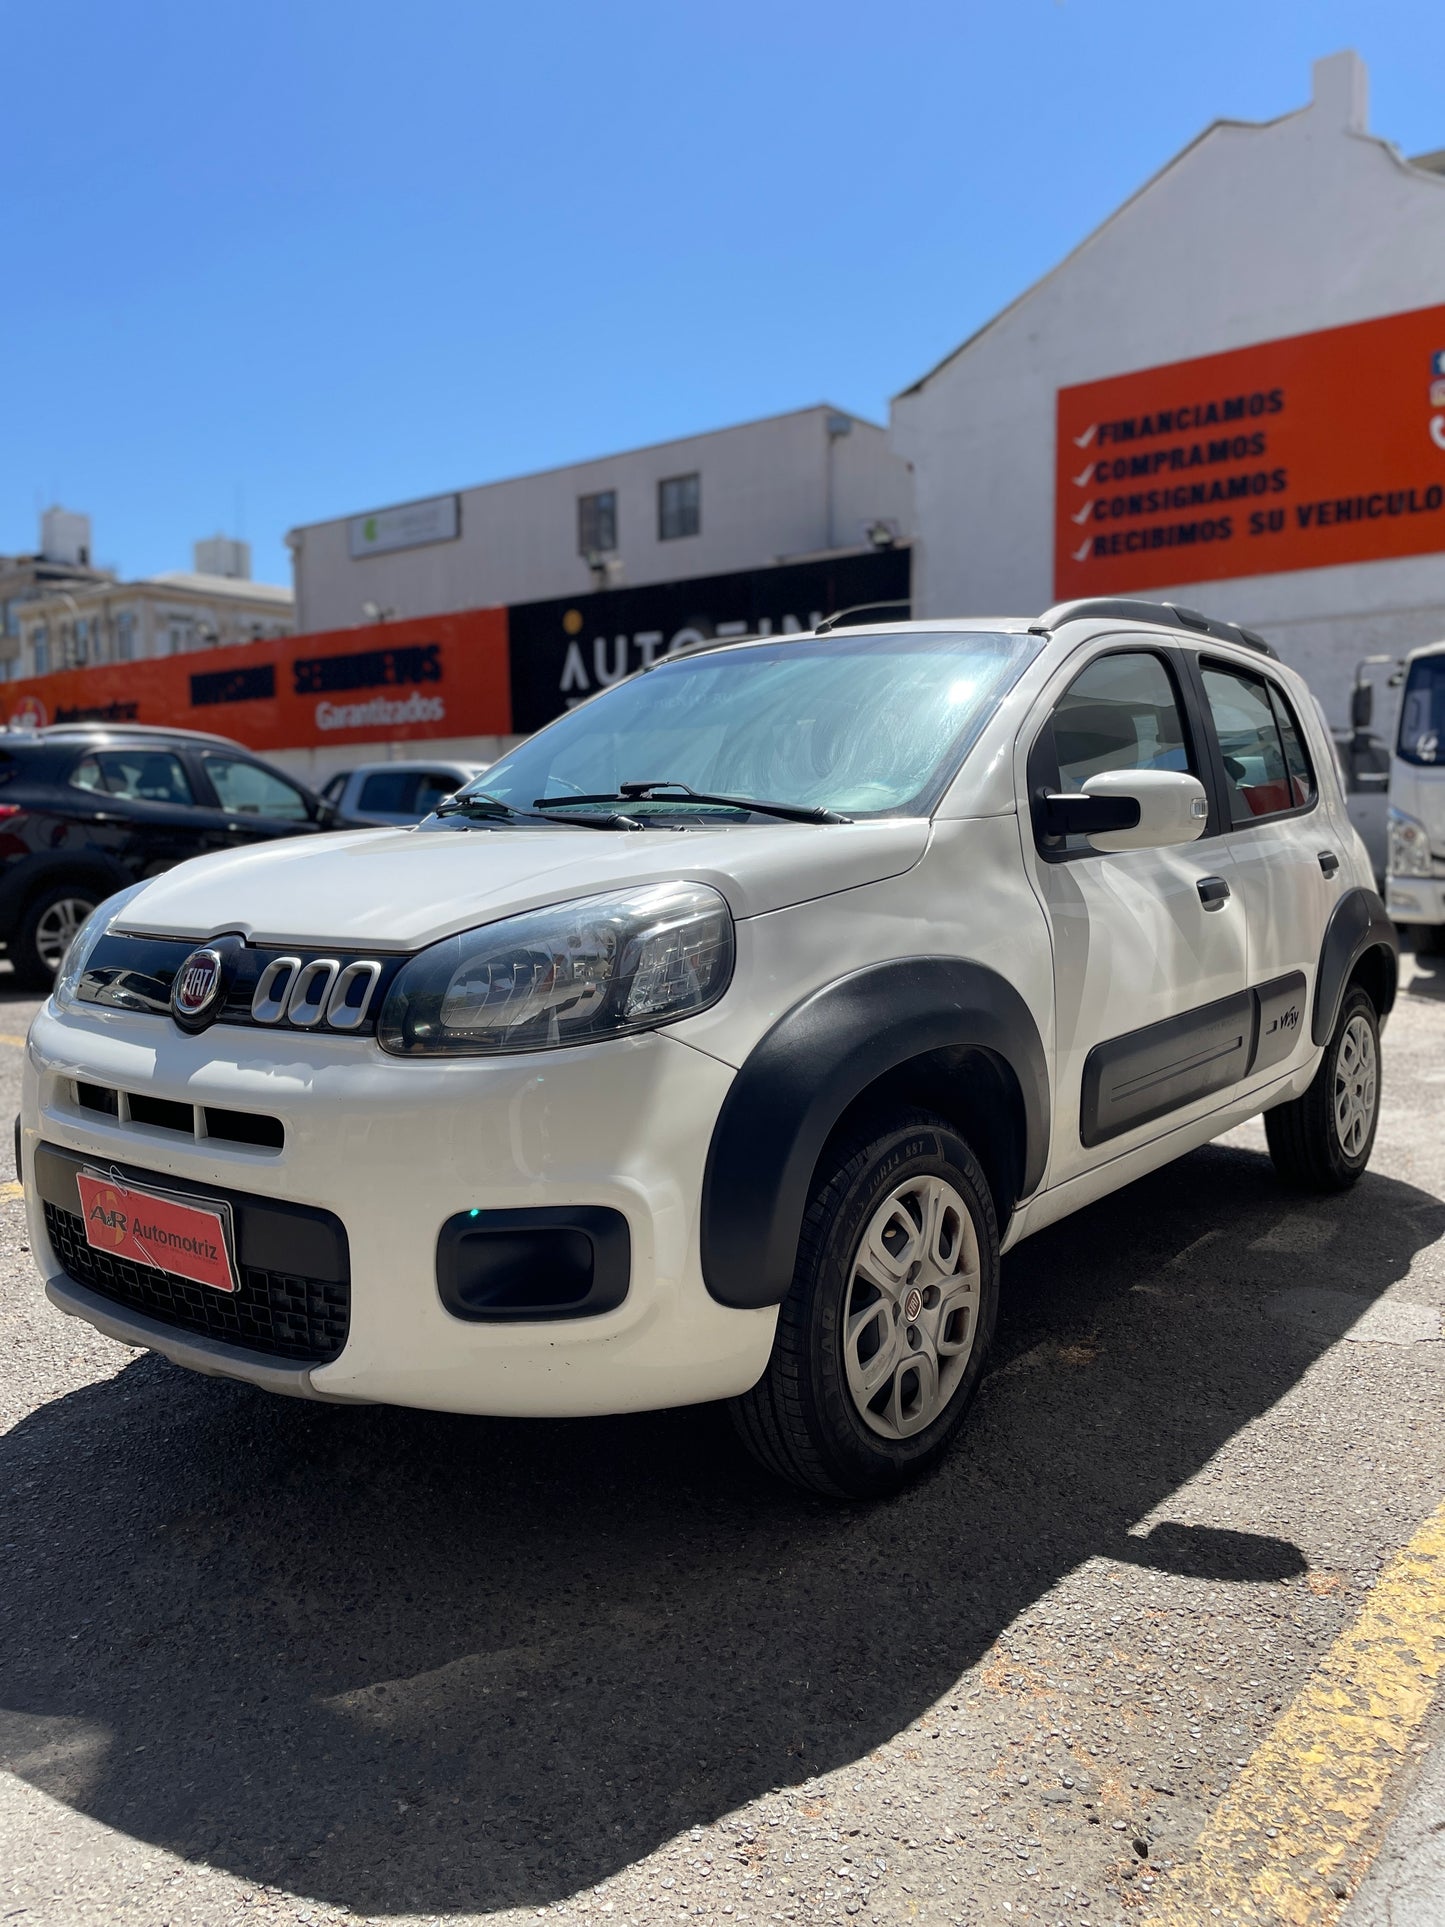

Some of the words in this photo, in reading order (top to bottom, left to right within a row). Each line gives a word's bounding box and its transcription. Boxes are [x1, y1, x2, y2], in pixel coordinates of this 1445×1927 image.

[1097, 388, 1285, 446] FINANCIAMOS
[1093, 432, 1267, 484] COMPRAMOS
[1091, 516, 1233, 559] RECIBIMOS
[1248, 510, 1286, 535] SU
[1296, 484, 1444, 529] VEHICULO
[1092, 469, 1288, 522] CONSIGNAMOS
[316, 690, 446, 731] Garantizados
[184, 967, 212, 997] FIAT
[132, 1218, 218, 1261] Automotriz
